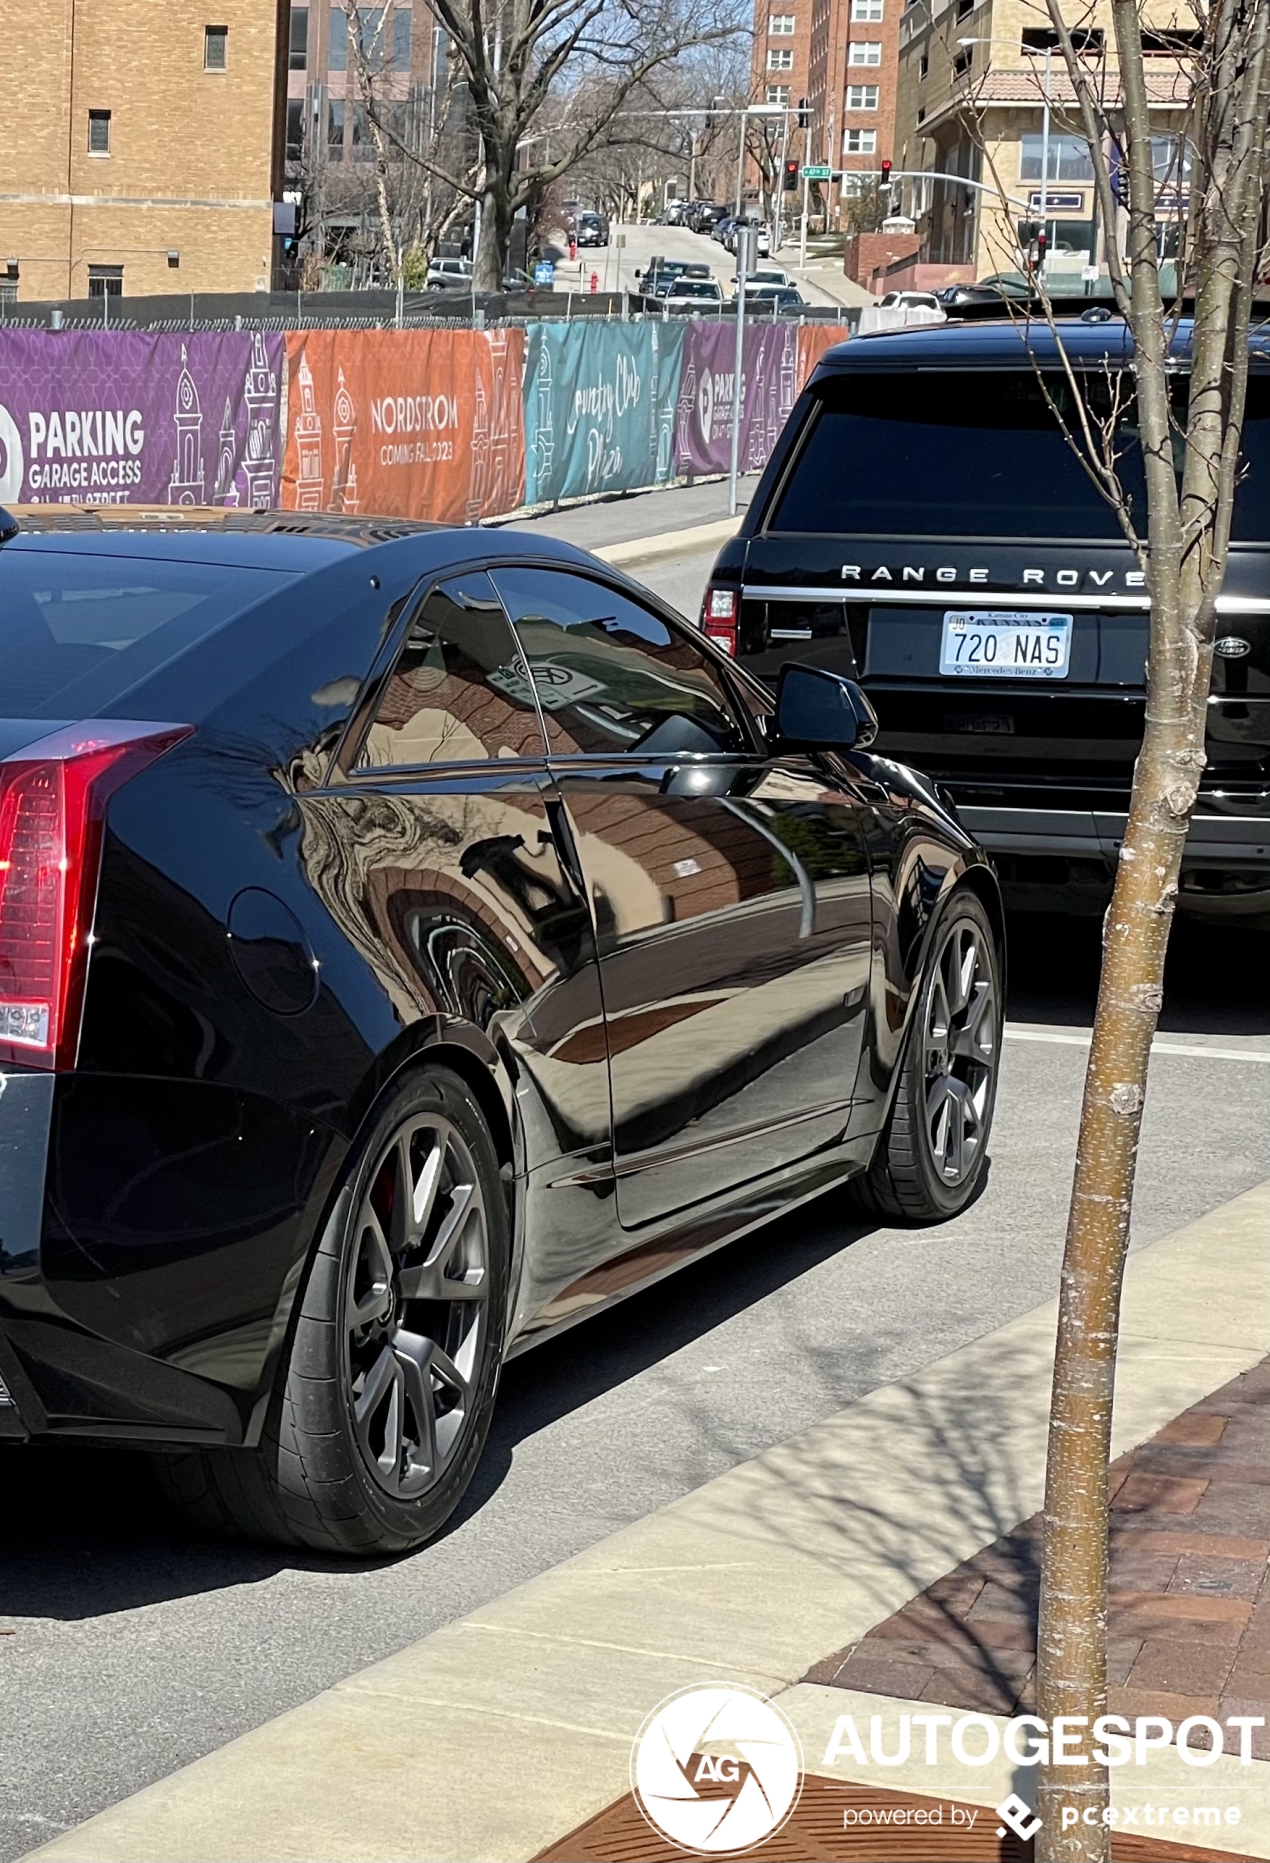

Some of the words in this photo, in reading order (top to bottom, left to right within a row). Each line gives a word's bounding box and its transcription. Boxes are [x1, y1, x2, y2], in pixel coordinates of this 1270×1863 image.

[821, 168, 829, 176] ST
[615, 353, 641, 417] Club
[371, 394, 458, 434] NORDSTROM
[29, 409, 145, 458] PARKING
[380, 444, 414, 466] COMING
[29, 462, 89, 489] GARAGE
[90, 459, 142, 486] ACCESS
[841, 565, 990, 583] RANGE
[1022, 569, 1146, 587] ROVE
[954, 633, 998, 662] 720
[1014, 634, 1061, 664] NAS
